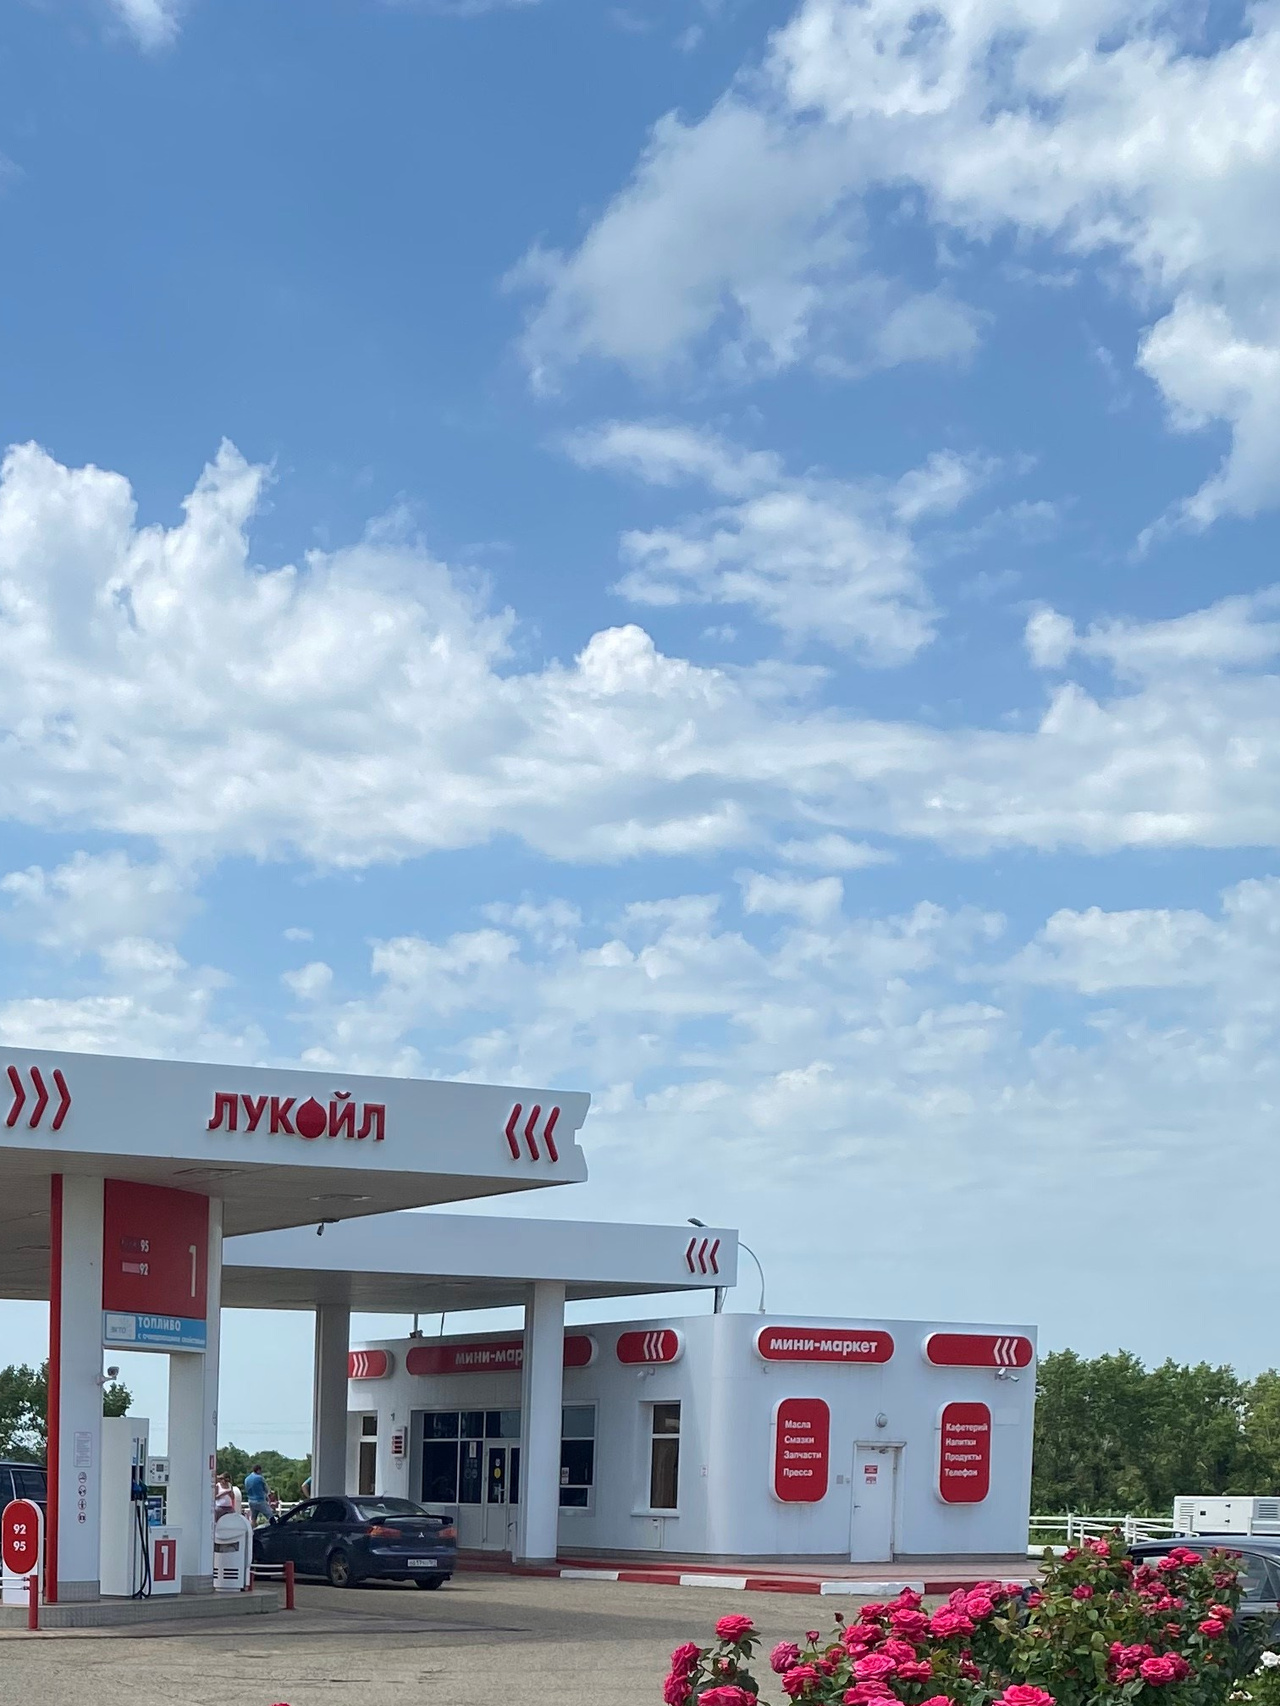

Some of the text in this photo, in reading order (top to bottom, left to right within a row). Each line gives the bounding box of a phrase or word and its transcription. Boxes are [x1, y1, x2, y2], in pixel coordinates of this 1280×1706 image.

[207, 1090, 386, 1140] ЛУКОЙЛ
[140, 1239, 150, 1253] 95
[139, 1263, 149, 1276] 92
[188, 1244, 197, 1298] 1
[138, 1316, 182, 1332] ТОПЛИВО
[770, 1339, 878, 1356] мини-маркет
[455, 1349, 524, 1365] мини-мар
[784, 1420, 811, 1429] Масла
[945, 1423, 988, 1433] Кафетерий
[784, 1435, 815, 1444] Смазки
[783, 1450, 822, 1459] Запчасти
[945, 1452, 982, 1462] Продукты
[783, 1468, 813, 1478] Пресса
[944, 1468, 978, 1478] Телефон
[13, 1523, 27, 1535] 92
[13, 1541, 27, 1552] 95
[161, 1545, 169, 1575] 1
